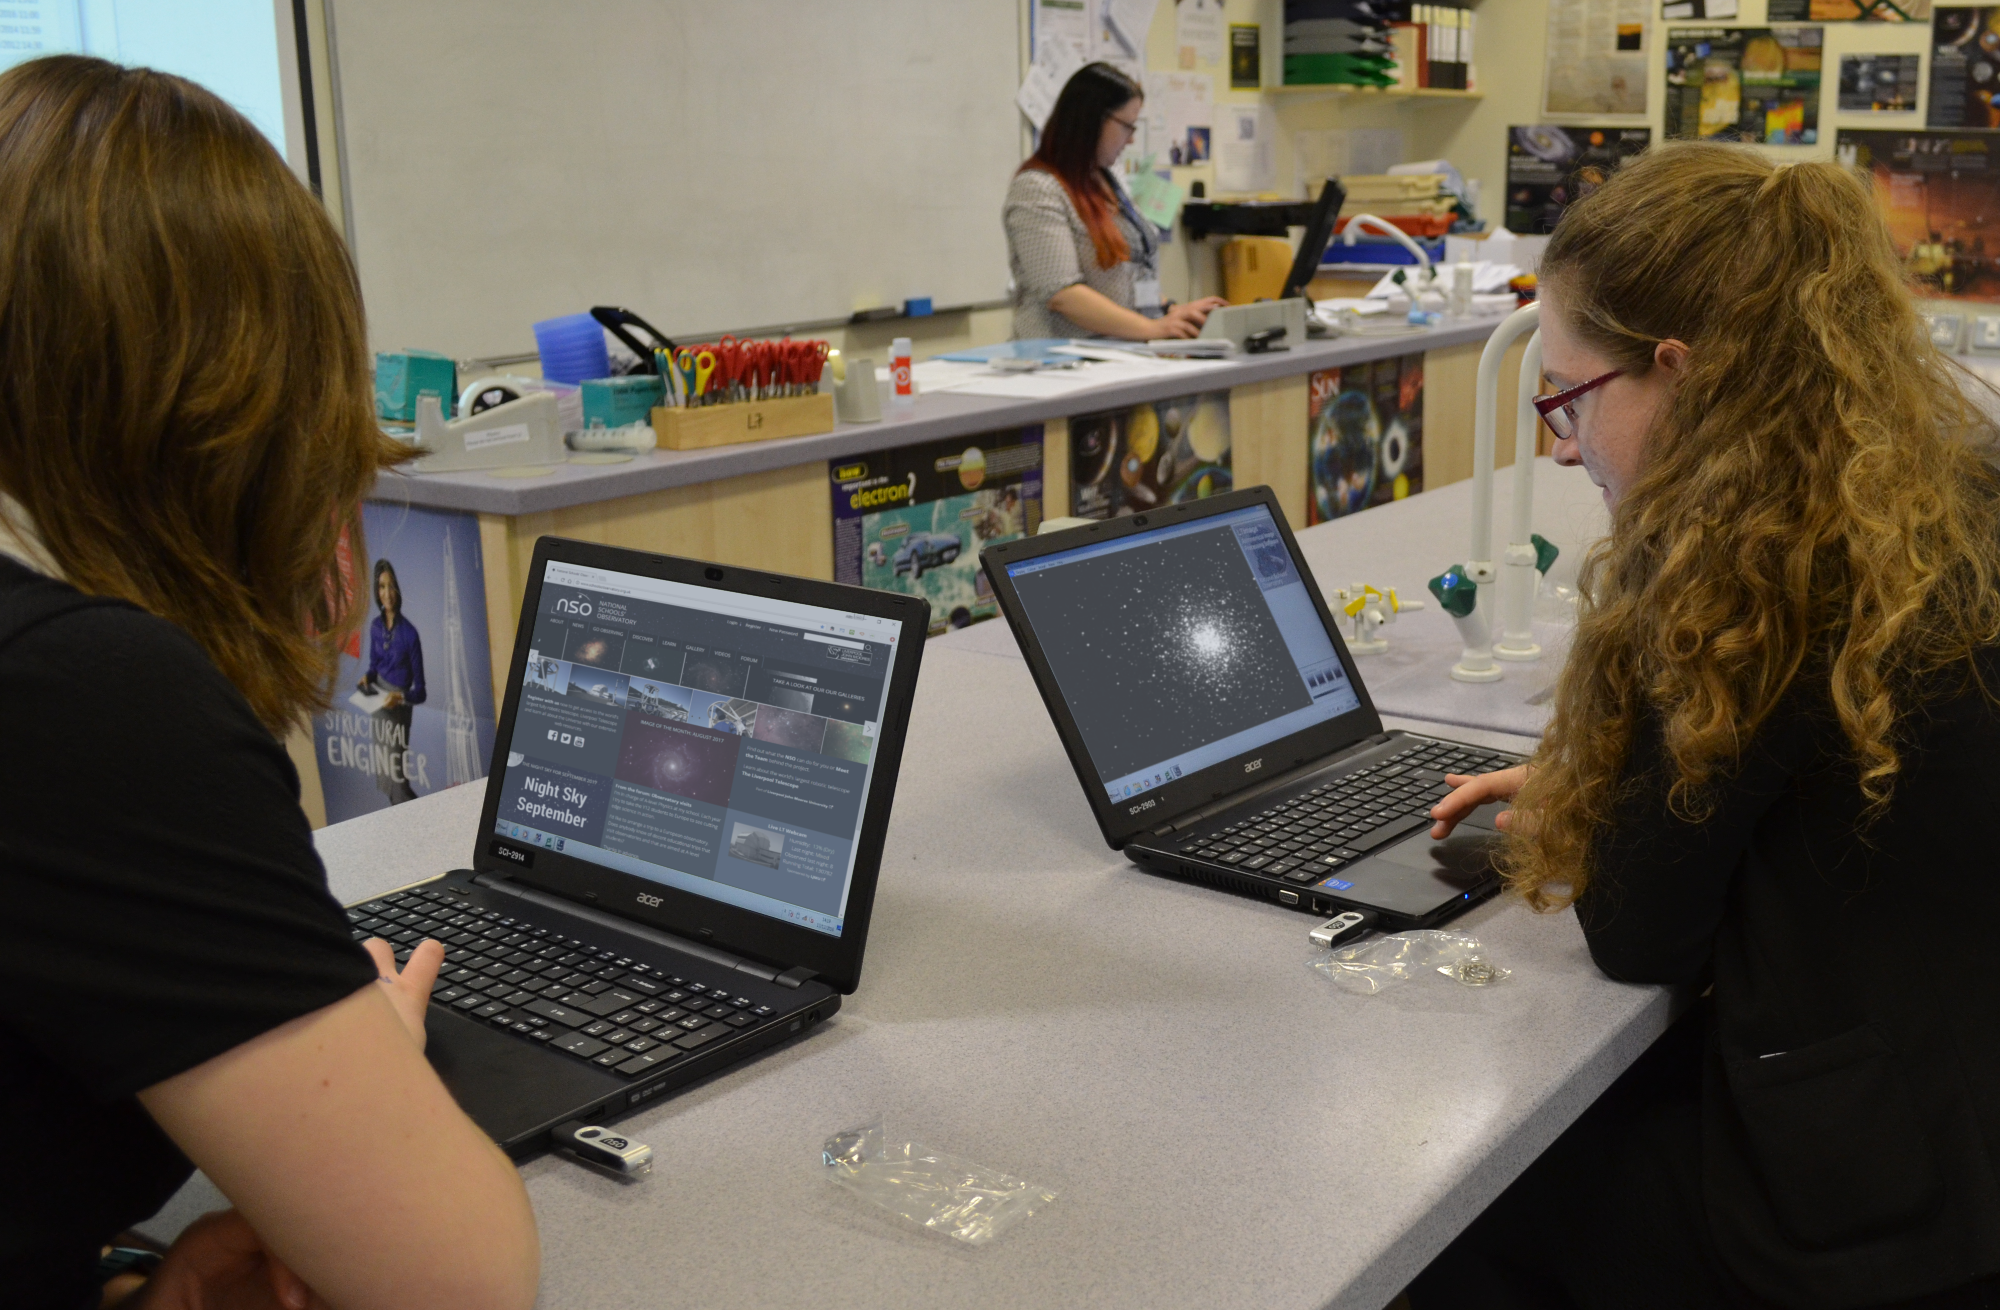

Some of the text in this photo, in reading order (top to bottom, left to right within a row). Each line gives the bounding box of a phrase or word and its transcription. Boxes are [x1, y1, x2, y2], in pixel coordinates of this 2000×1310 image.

[556, 598, 592, 616] nso
[599, 601, 627, 610] NATIONAL
[597, 613, 637, 625] OBSERVATORY
[600, 628, 623, 636] OBSERVING
[685, 645, 705, 653] GALLERY
[838, 691, 865, 701] GALLERIES
[325, 709, 410, 749] STRUCTURAL
[673, 727, 691, 736] MONTH:
[692, 732, 711, 740] AUGUST
[327, 735, 431, 790] ENGINEER
[1244, 758, 1263, 773] acer
[562, 772, 587, 782] SEPTEMBER
[751, 774, 774, 783] Liverpool
[775, 779, 799, 789] Telescope
[524, 775, 587, 809] Night Sky
[517, 795, 587, 828] September
[1129, 799, 1156, 815] SCI-2903
[786, 829, 807, 838] Webcam
[498, 846, 525, 862] SCI-2914
[636, 892, 664, 908] acer
[604, 1138, 624, 1149] nso
